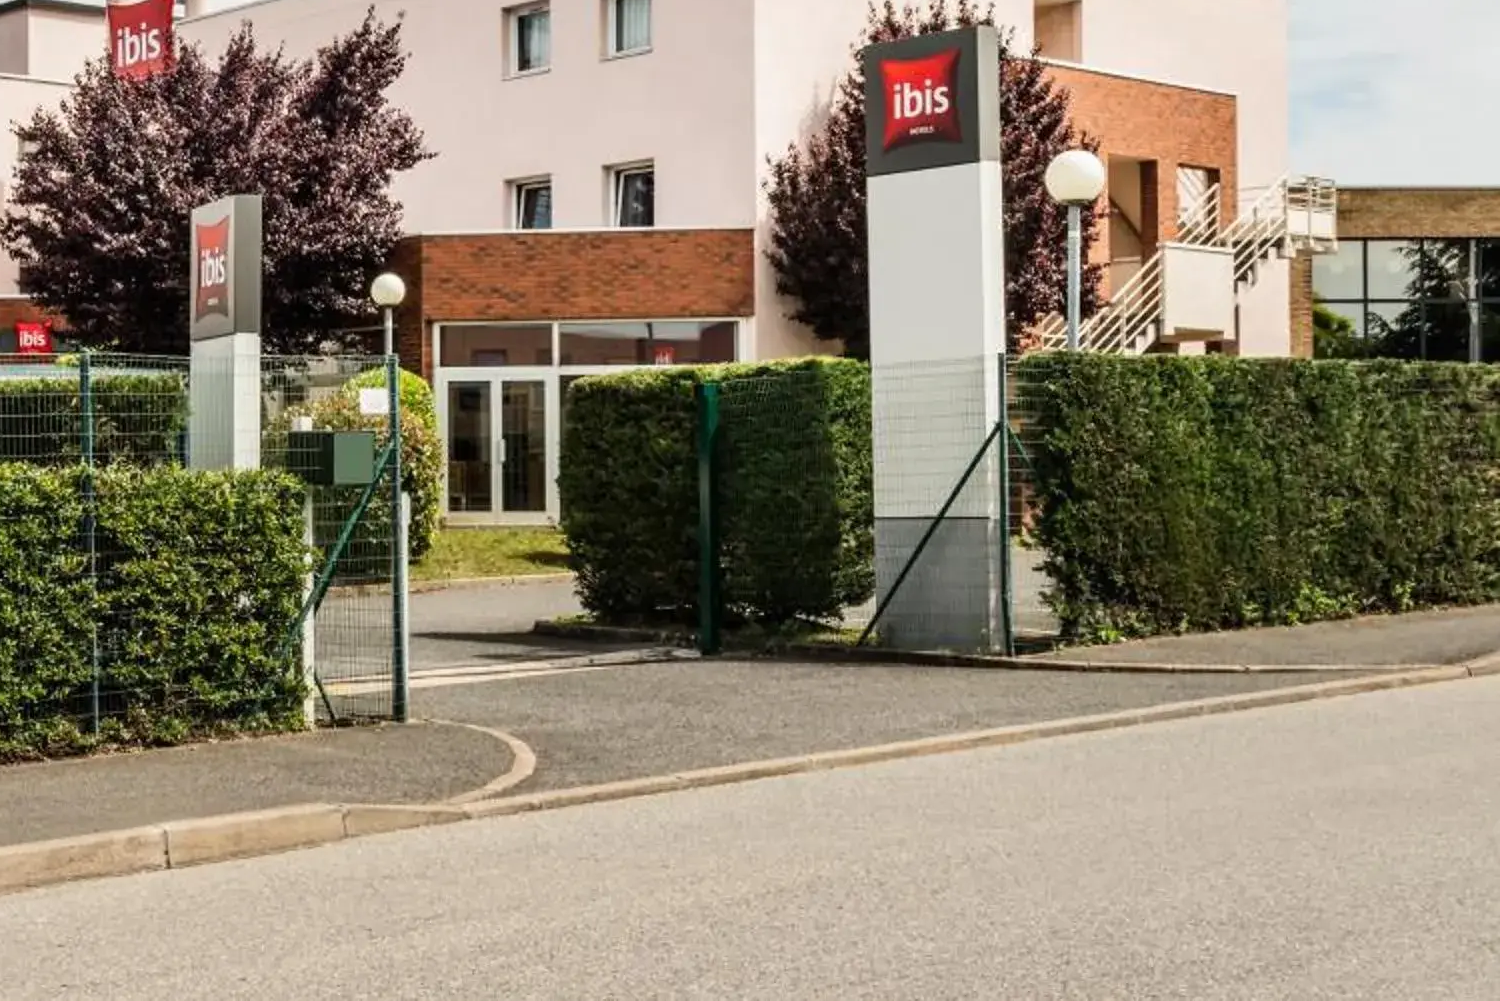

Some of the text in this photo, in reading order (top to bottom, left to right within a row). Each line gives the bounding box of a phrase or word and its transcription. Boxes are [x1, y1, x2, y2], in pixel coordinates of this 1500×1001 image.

[117, 22, 161, 68] ibis
[893, 78, 950, 120] ibis
[201, 246, 225, 288] ibis
[19, 330, 47, 348] ibis
